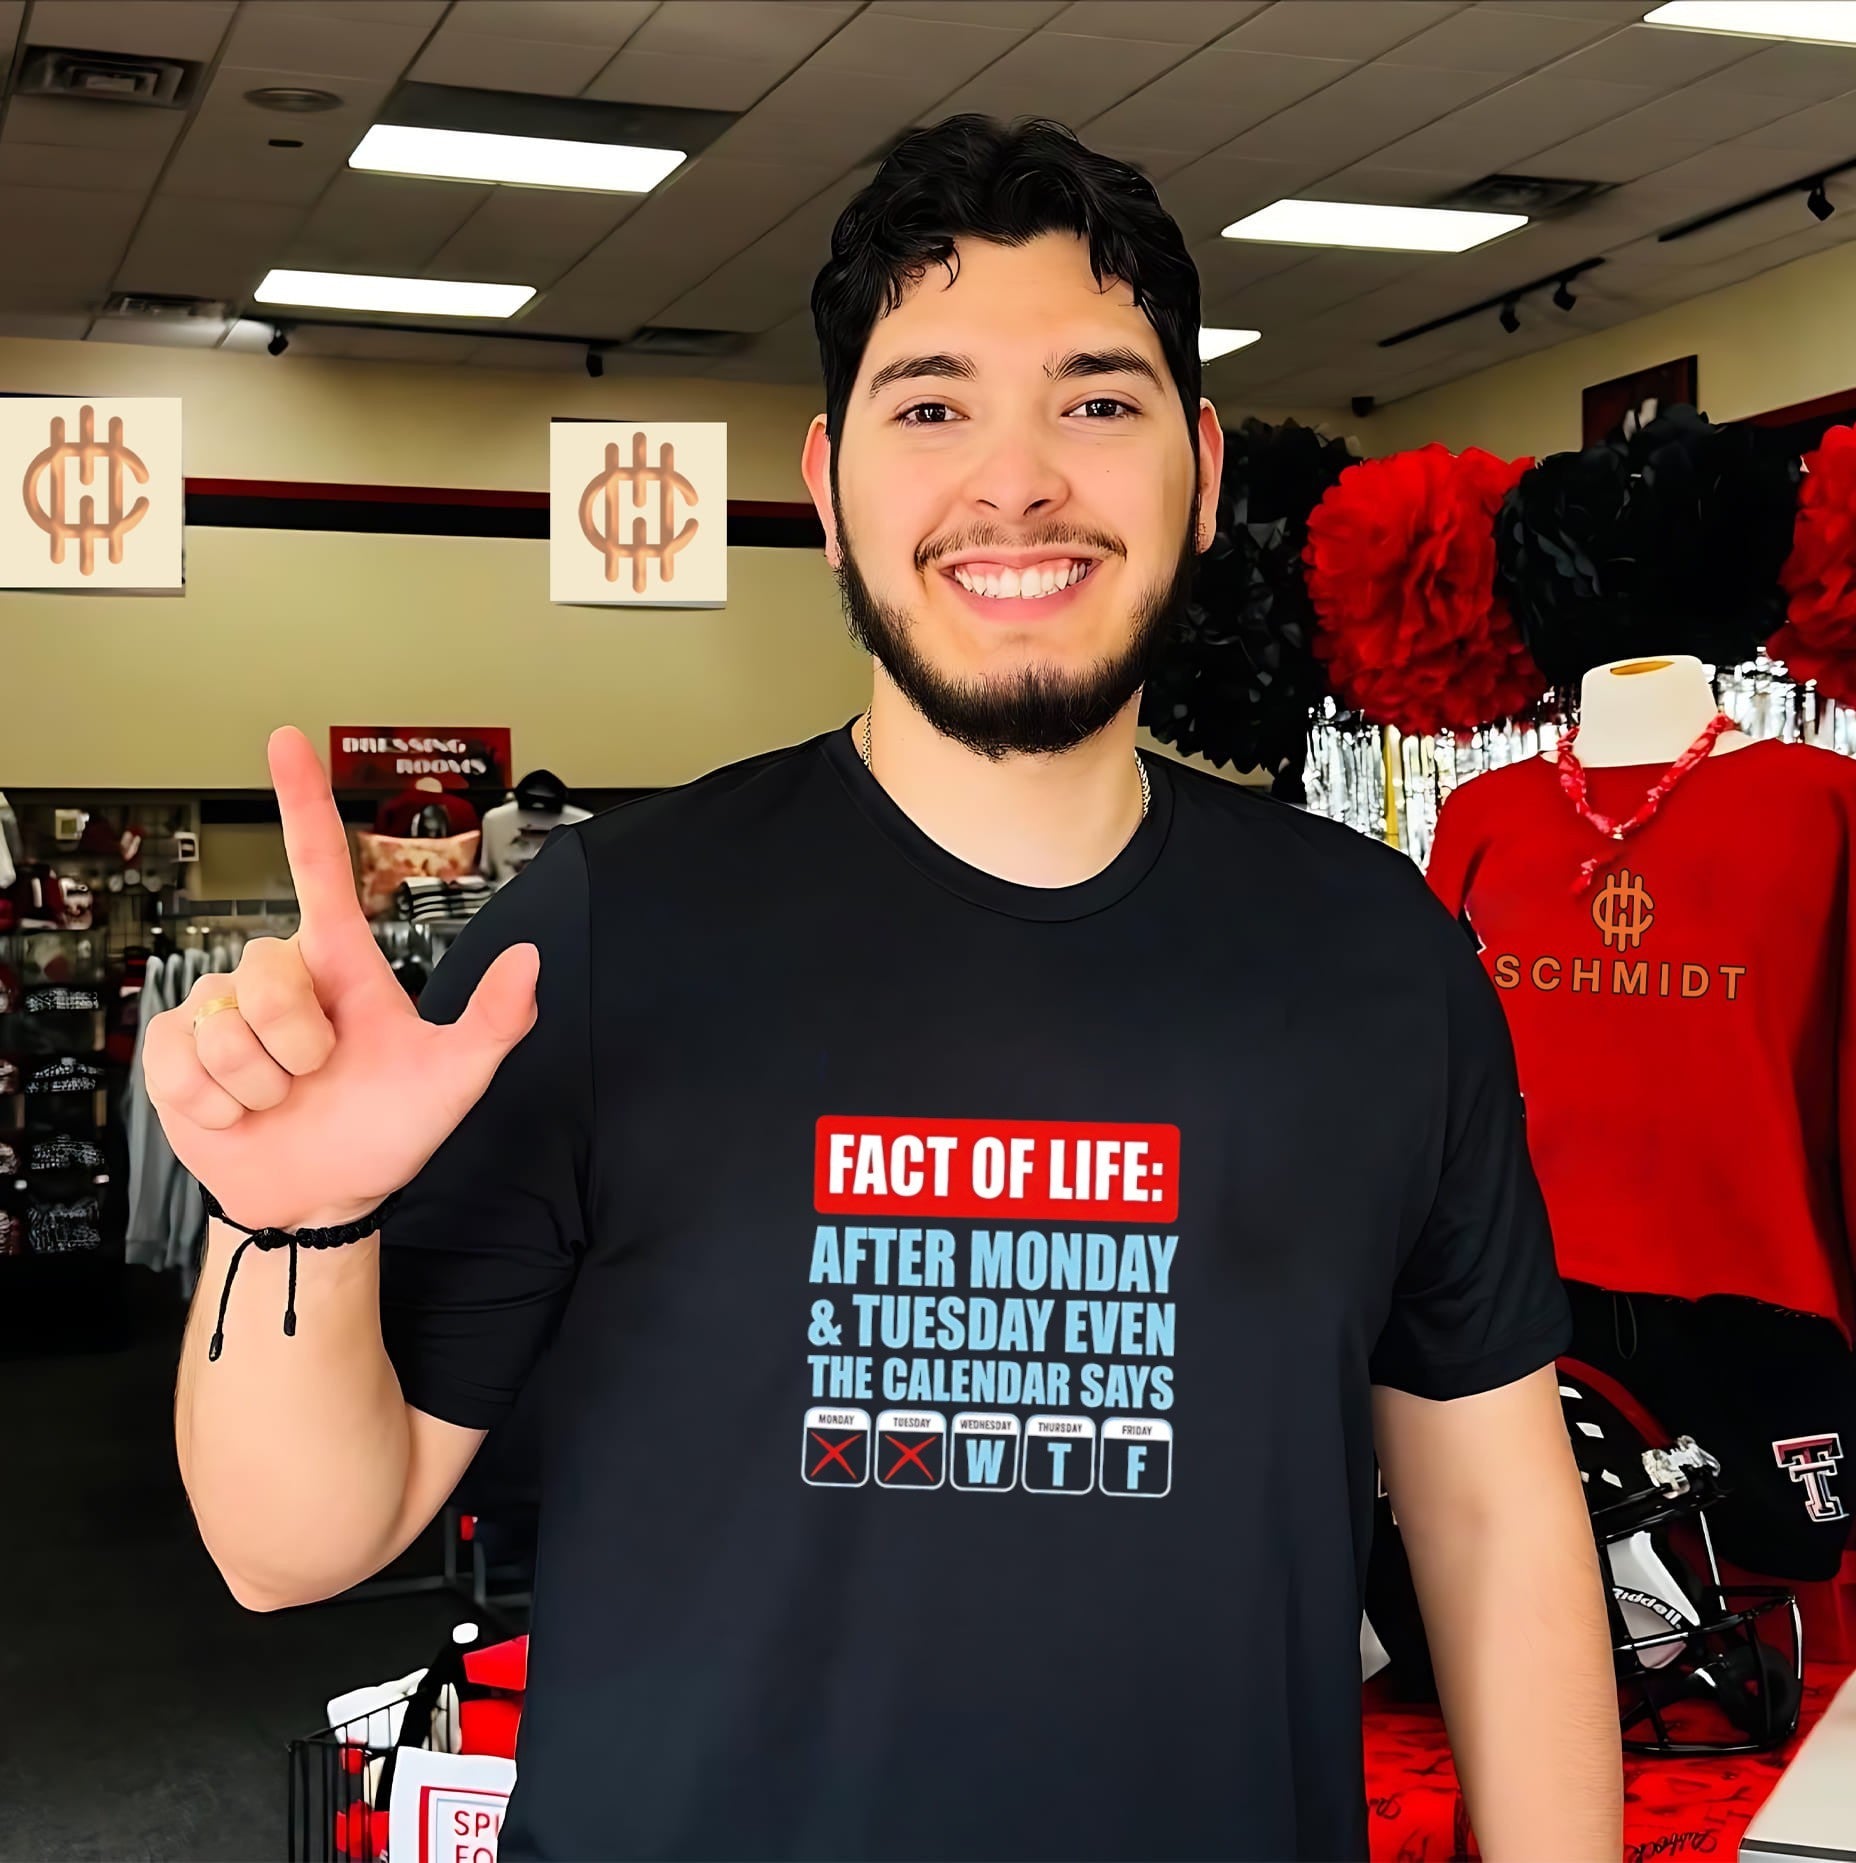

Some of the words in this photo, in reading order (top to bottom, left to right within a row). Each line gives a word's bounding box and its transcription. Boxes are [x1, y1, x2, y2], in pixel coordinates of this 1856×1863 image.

[396, 758, 487, 775] ROOMS
[1493, 953, 1747, 1000] SCHMIDT
[828, 1133, 958, 1197] FACT
[971, 1136, 1035, 1199] OF
[1049, 1139, 1164, 1202] LIFE:
[808, 1225, 956, 1288] AFTER
[970, 1229, 1179, 1294] MONDAY
[807, 1299, 842, 1346] &
[852, 1294, 1055, 1352] TUESDAY
[1064, 1299, 1176, 1356] EVEN
[807, 1354, 873, 1399] THE
[882, 1357, 1071, 1406] CALENDAR
[1080, 1362, 1175, 1410] SAYS
[818, 1414, 854, 1426] MONDAY
[893, 1417, 931, 1429] TUESDAY
[960, 1420, 1012, 1432] WEDNESDAY
[1038, 1422, 1083, 1434] THURSDAY
[1121, 1425, 1152, 1437] FRIDAY
[965, 1439, 1006, 1485] W
[1047, 1442, 1073, 1487] T
[1126, 1445, 1148, 1490] F
